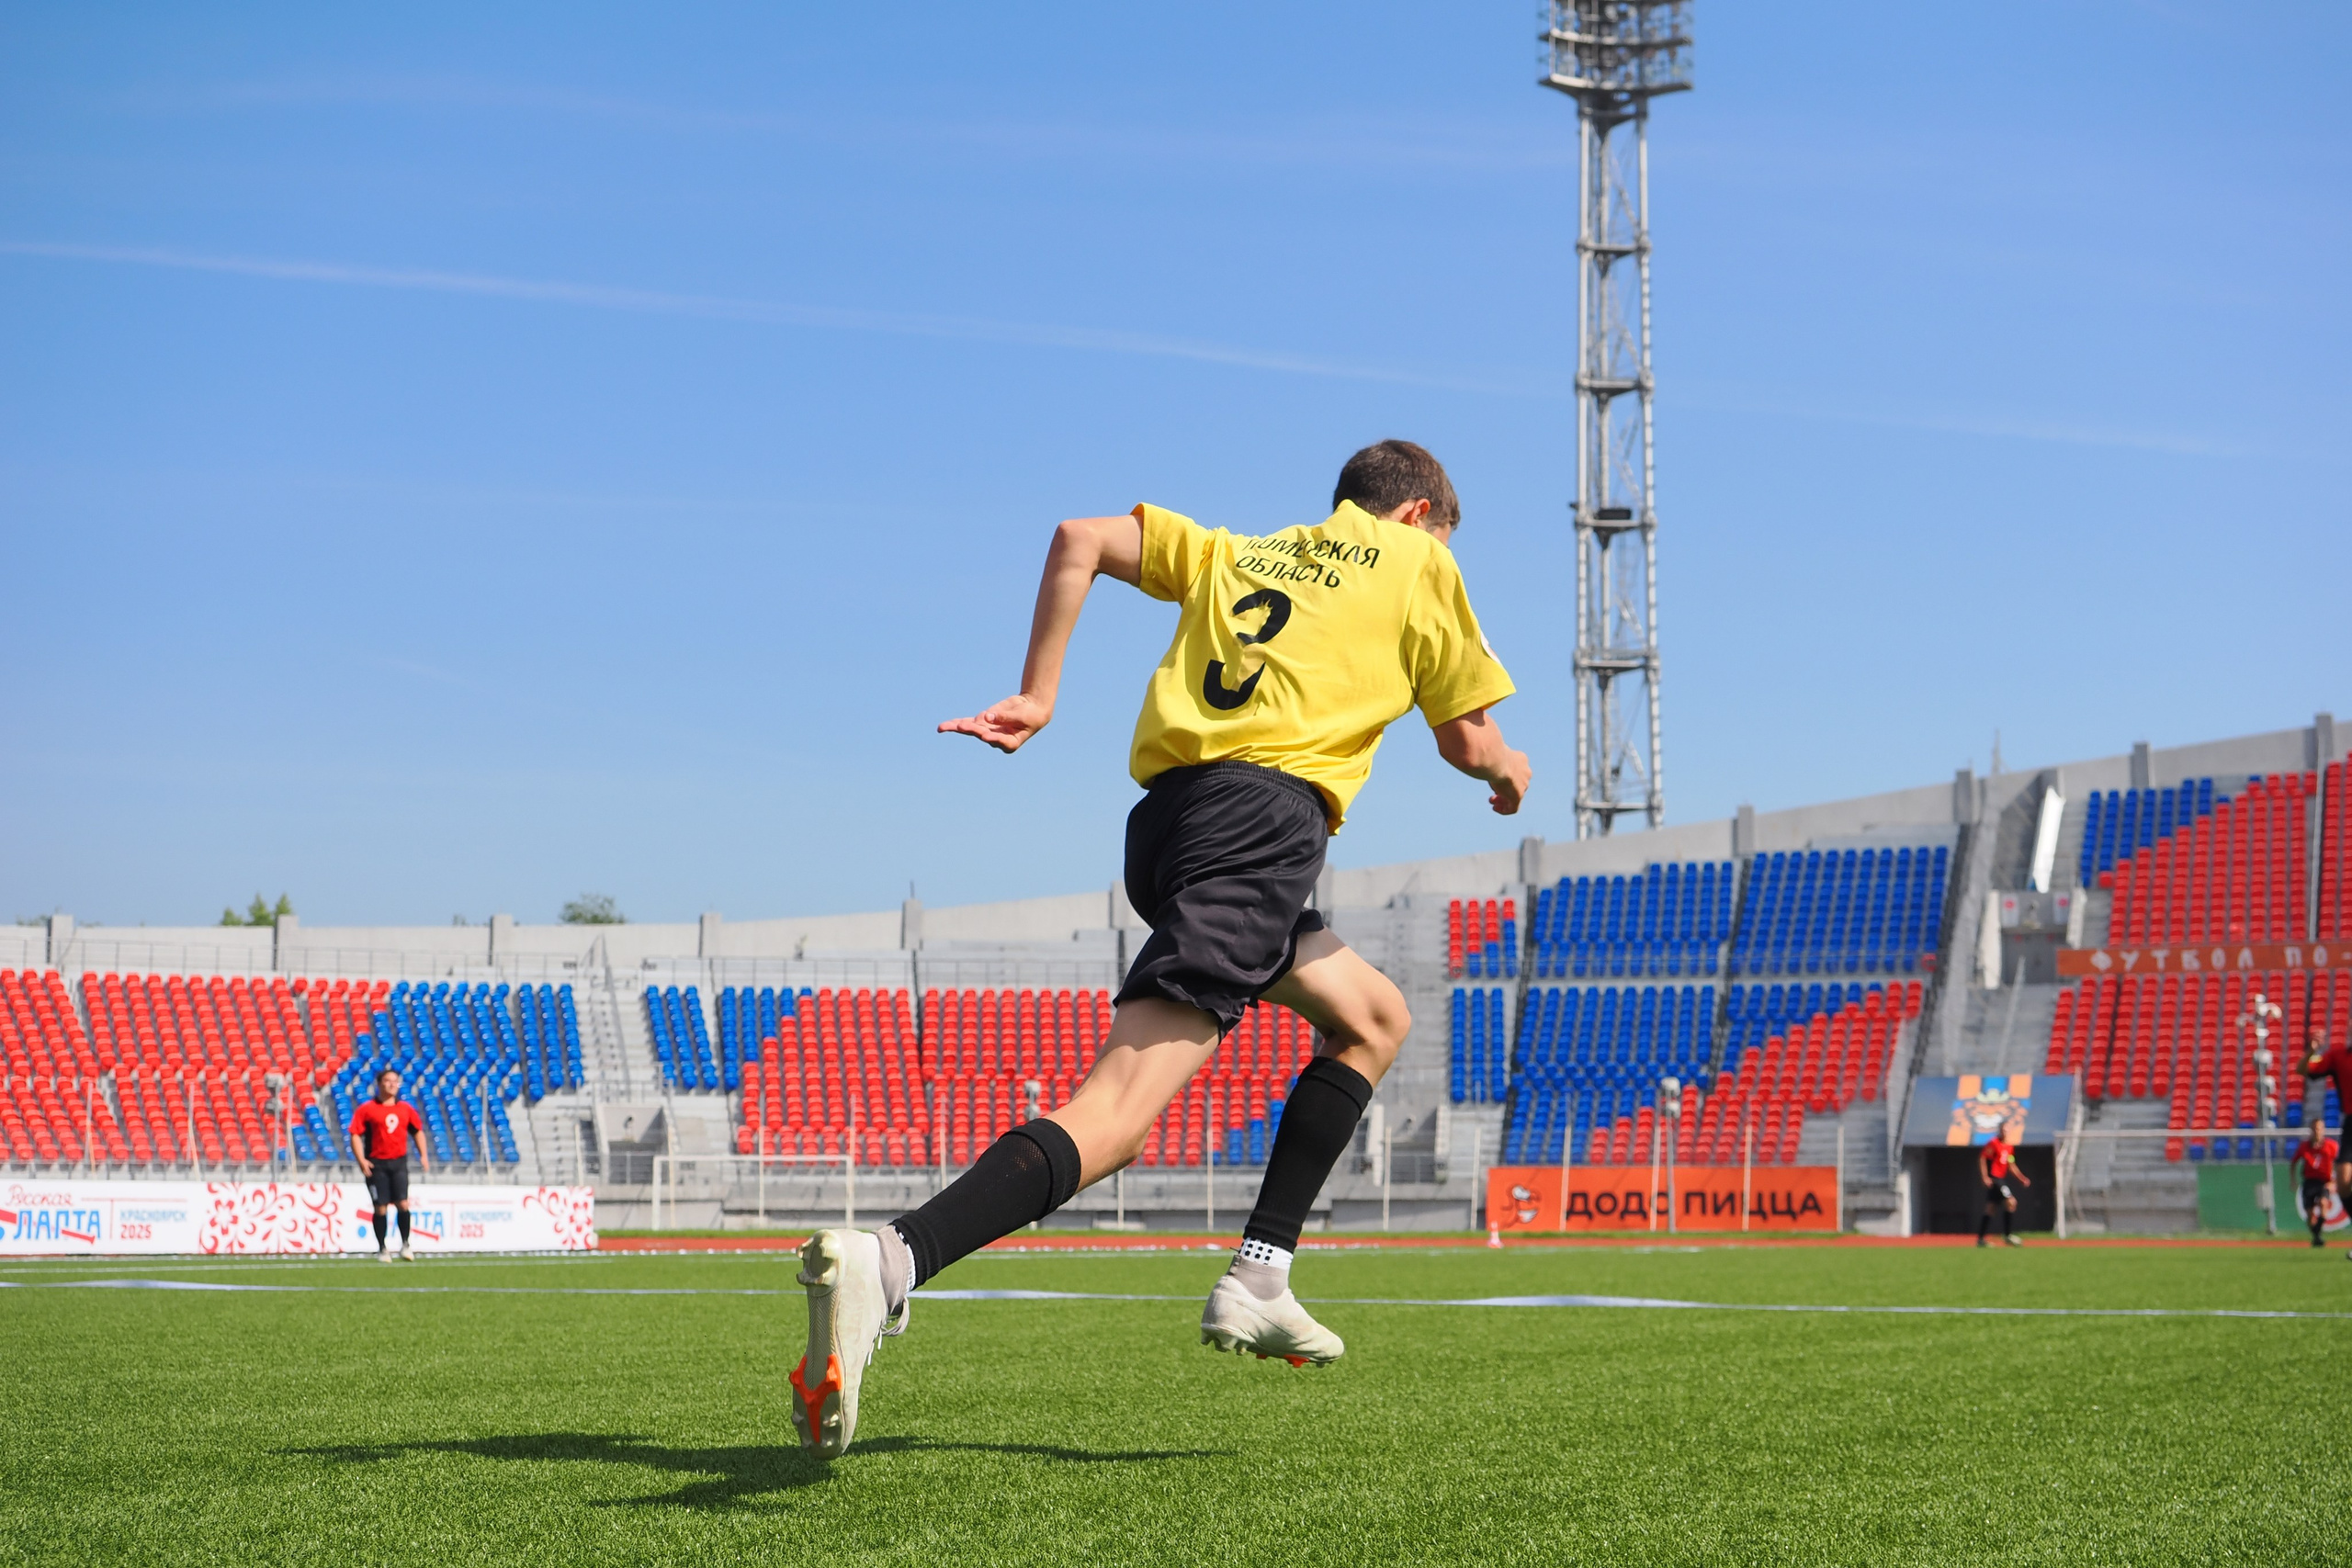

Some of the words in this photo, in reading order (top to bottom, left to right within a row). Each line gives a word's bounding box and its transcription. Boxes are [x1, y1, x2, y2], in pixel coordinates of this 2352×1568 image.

[1236, 556, 1340, 588] ОБЛАСТЬ
[1203, 588, 1292, 711] 3
[385, 1113, 400, 1134] 9
[1684, 1191, 1823, 1222] ПИЦЦА
[13, 1210, 101, 1240] ЛАПТА
[120, 1224, 152, 1239] 2025
